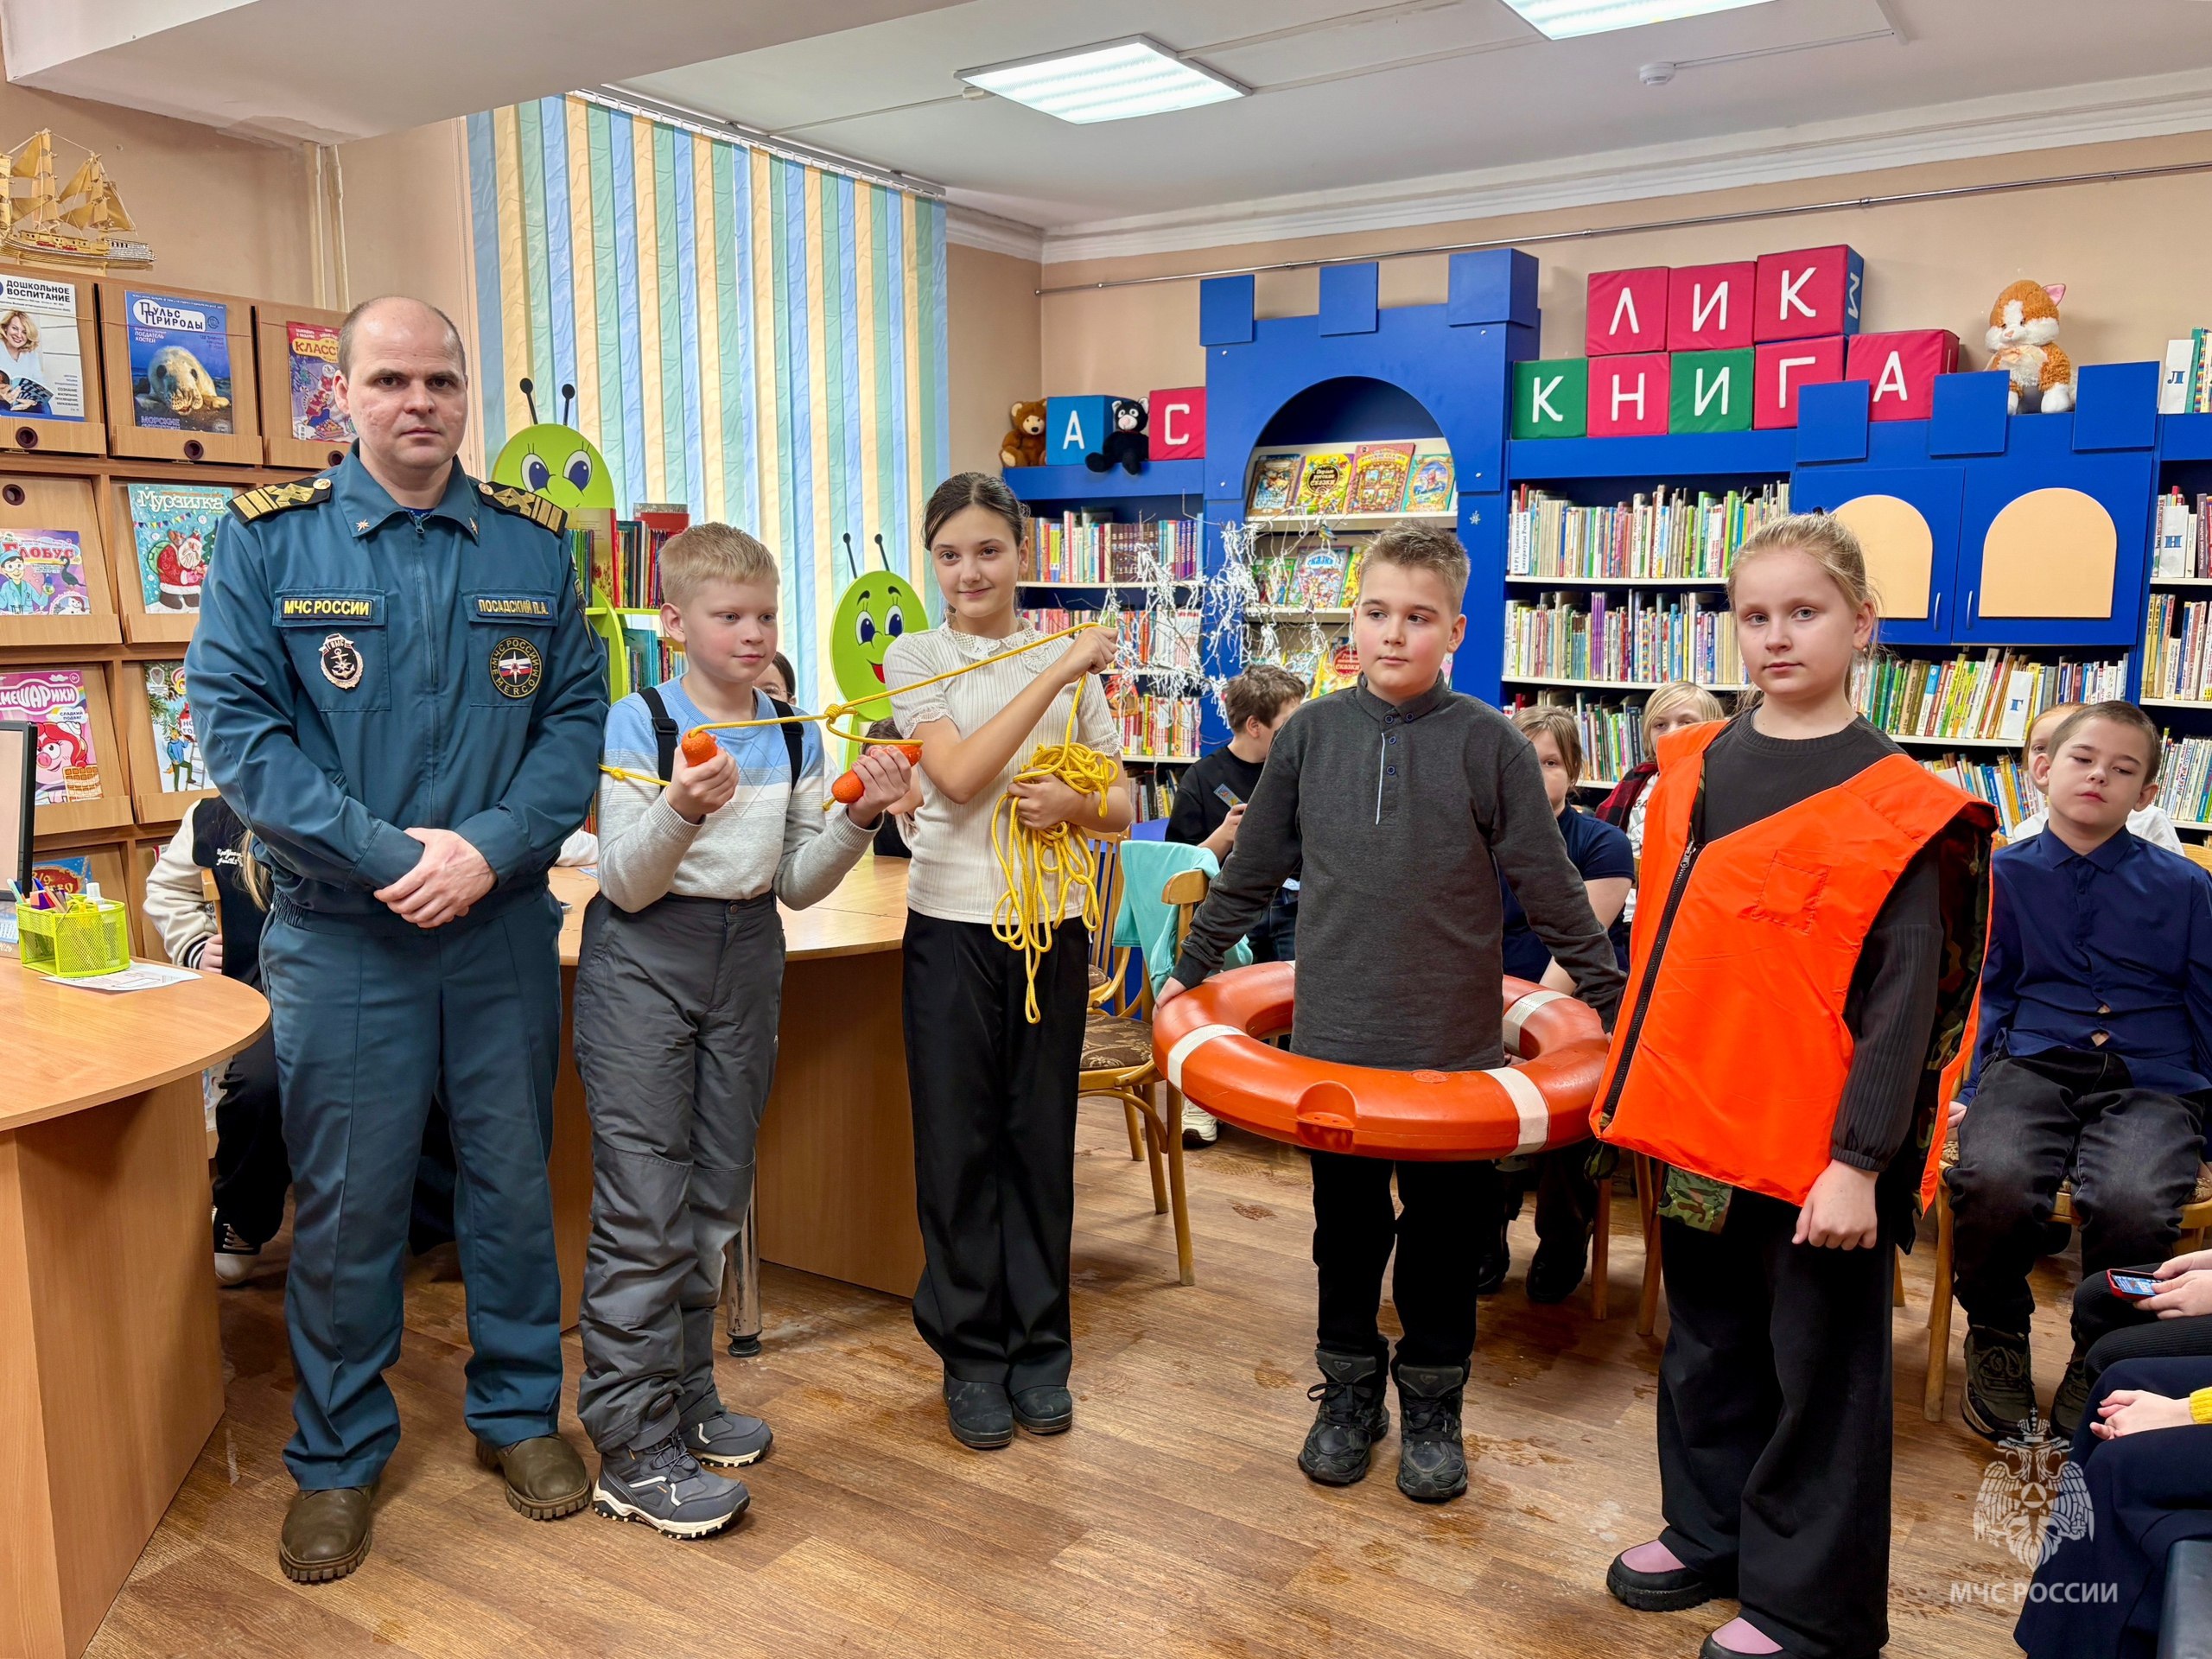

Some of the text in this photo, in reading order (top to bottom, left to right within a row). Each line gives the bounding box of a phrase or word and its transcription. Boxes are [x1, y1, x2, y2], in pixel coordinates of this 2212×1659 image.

[6, 280, 70, 294] ДОШКОЛЬНОЕ
[6, 288, 71, 302] ВОСПИТАНИЕ
[295, 340, 339, 356] КЛАСС
[2167, 371, 2185, 385] Л
[137, 490, 226, 512] Мурзилка
[2164, 535, 2183, 549] Н
[283, 600, 370, 616] МЧС РОССИИ
[492, 639, 539, 667] МЧС РОССИИ
[492, 669, 539, 695] EMERCOM
[0, 684, 75, 708] МЕШАРИКИ
[2010, 698, 2024, 712] Г
